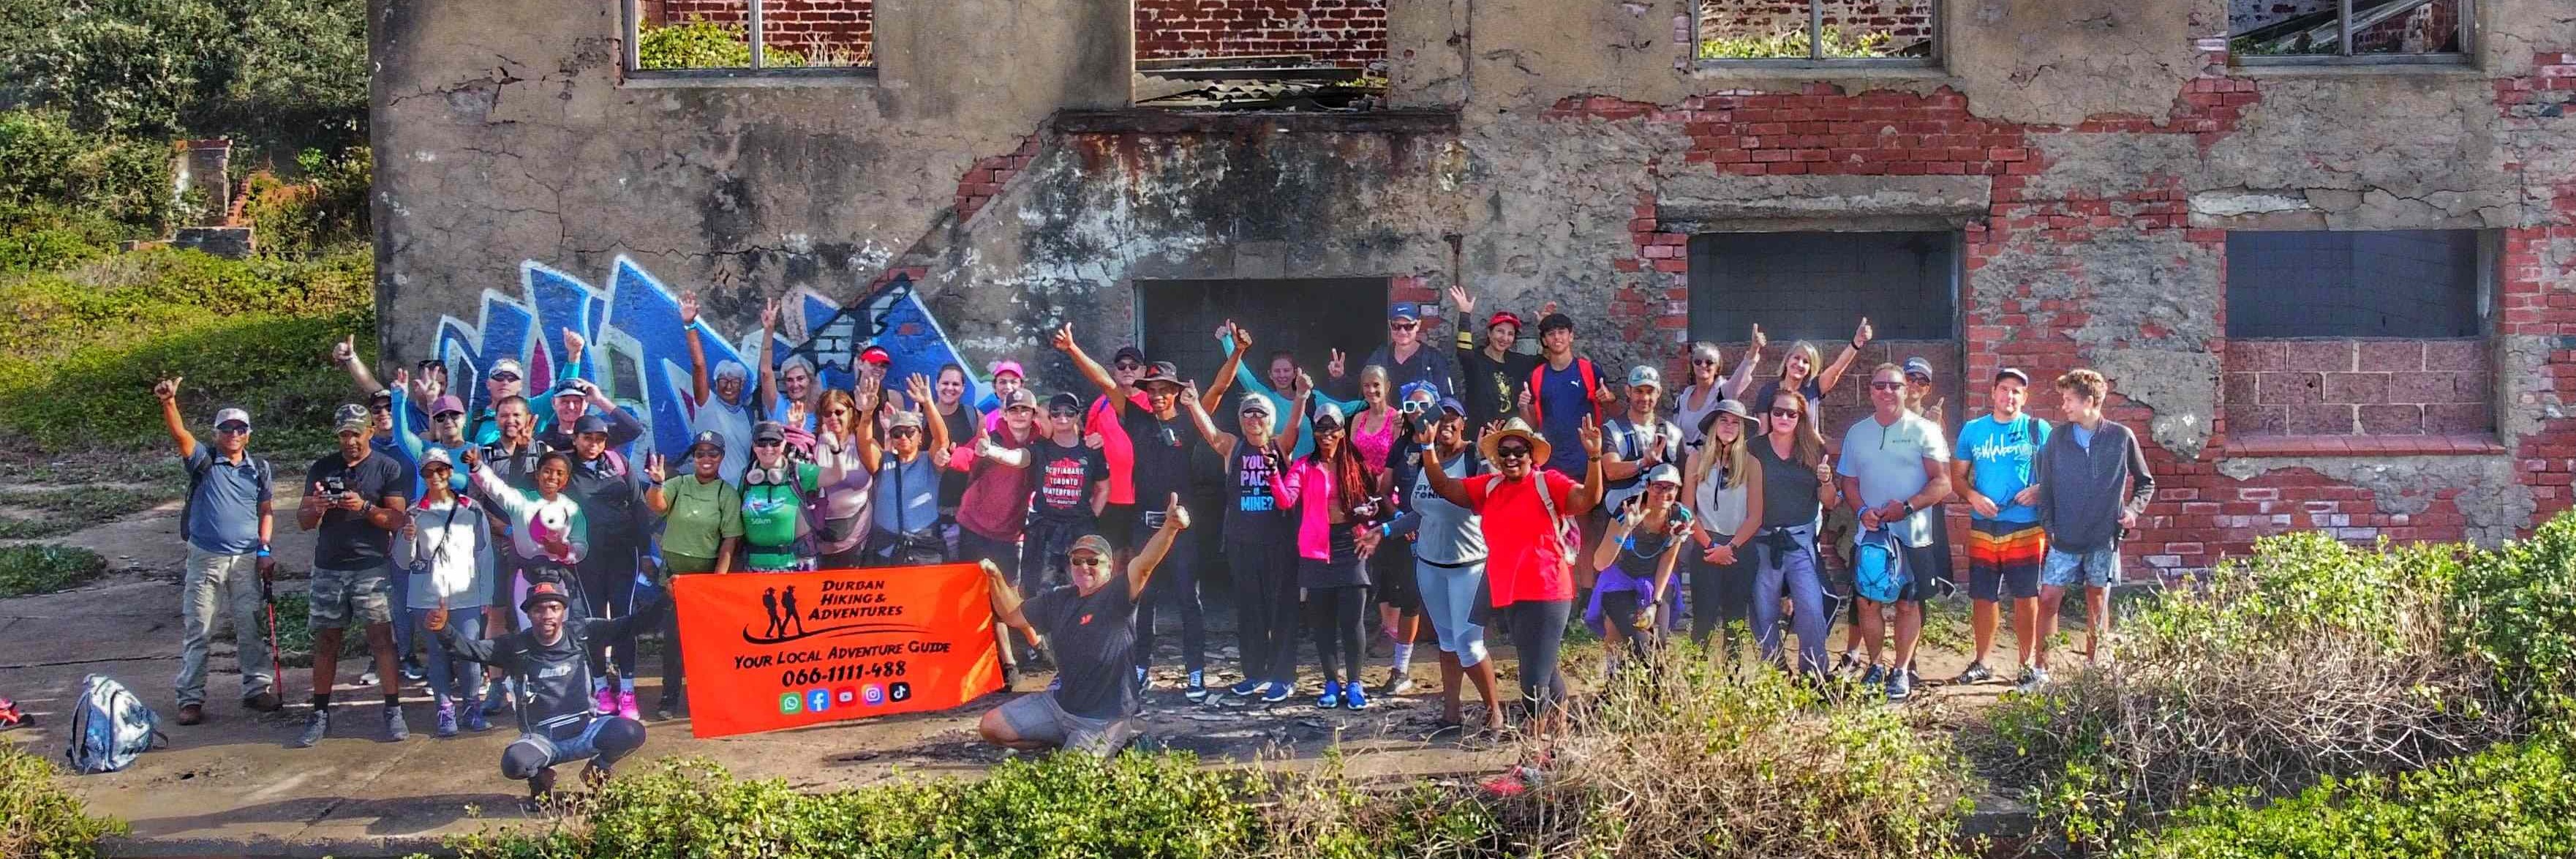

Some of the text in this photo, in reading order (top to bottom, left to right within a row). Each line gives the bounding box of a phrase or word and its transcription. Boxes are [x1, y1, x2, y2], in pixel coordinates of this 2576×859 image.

[1242, 455, 1268, 470] YOU
[1050, 477, 1079, 486] TORONTO
[1042, 487, 1082, 497] WATERFRONT
[1240, 496, 1274, 511] MINE?
[821, 580, 884, 592] DURBAN
[821, 593, 886, 606] HIKING &
[808, 606, 903, 620] ADVENTURES
[734, 639, 952, 669] YOUR LOCAL ADVENTURE GUIDE
[782, 661, 907, 687] 066-1111-488
